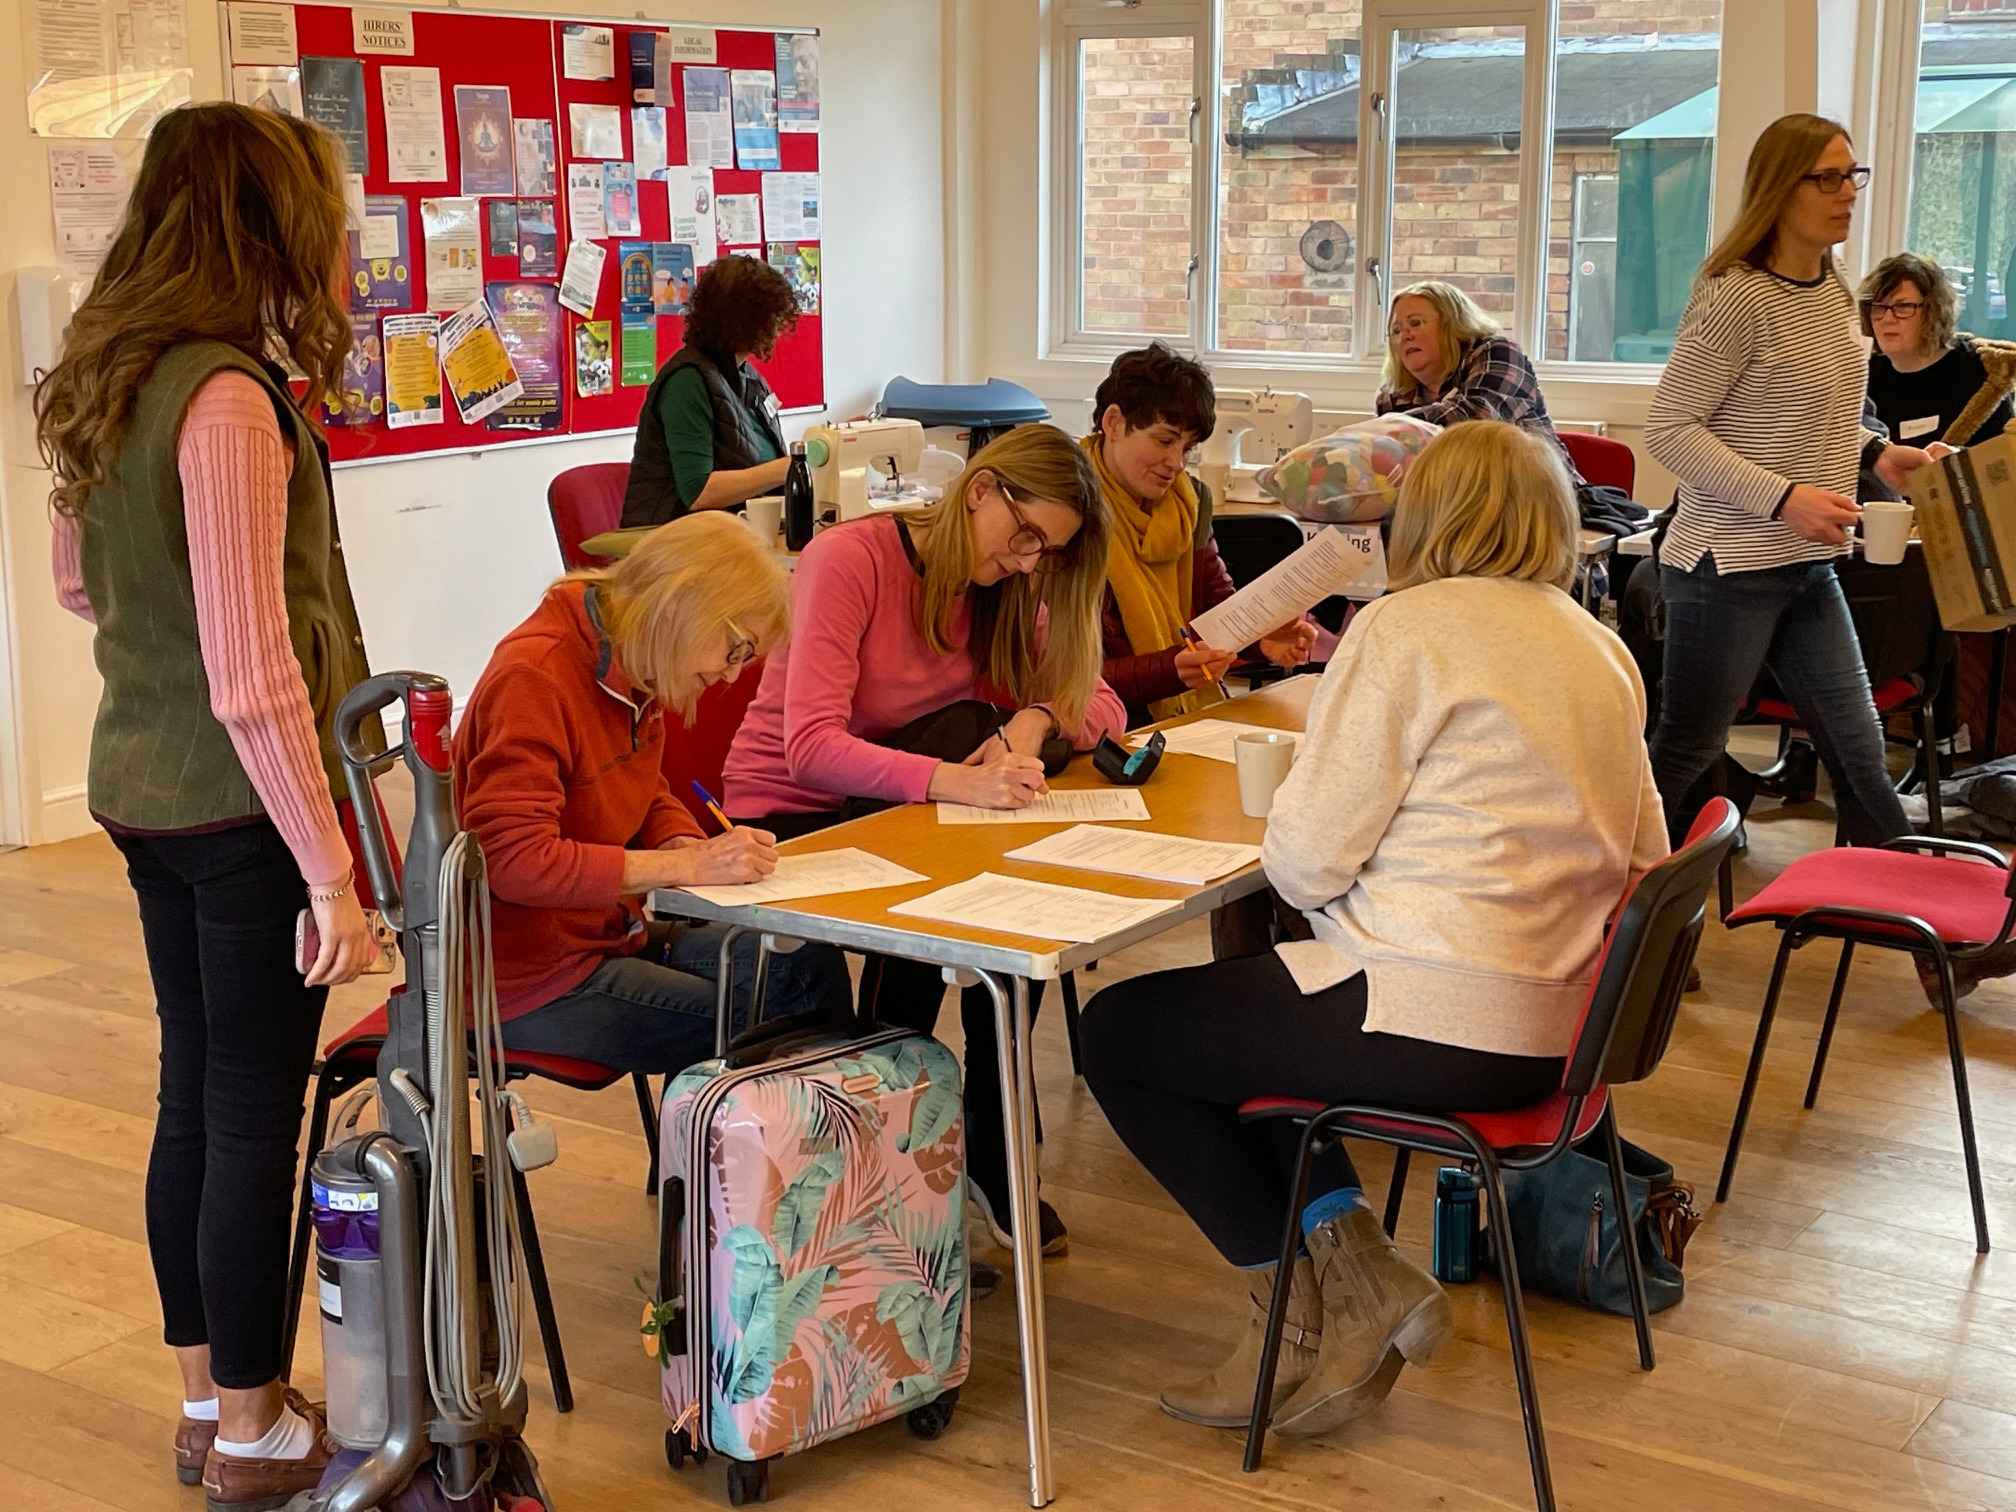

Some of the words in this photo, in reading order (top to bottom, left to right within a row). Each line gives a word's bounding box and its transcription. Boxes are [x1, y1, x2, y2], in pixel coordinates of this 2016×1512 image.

[362, 35, 406, 48] NOTICES
[684, 37, 703, 45] LOCAL
[674, 46, 712, 54] INFORMATION
